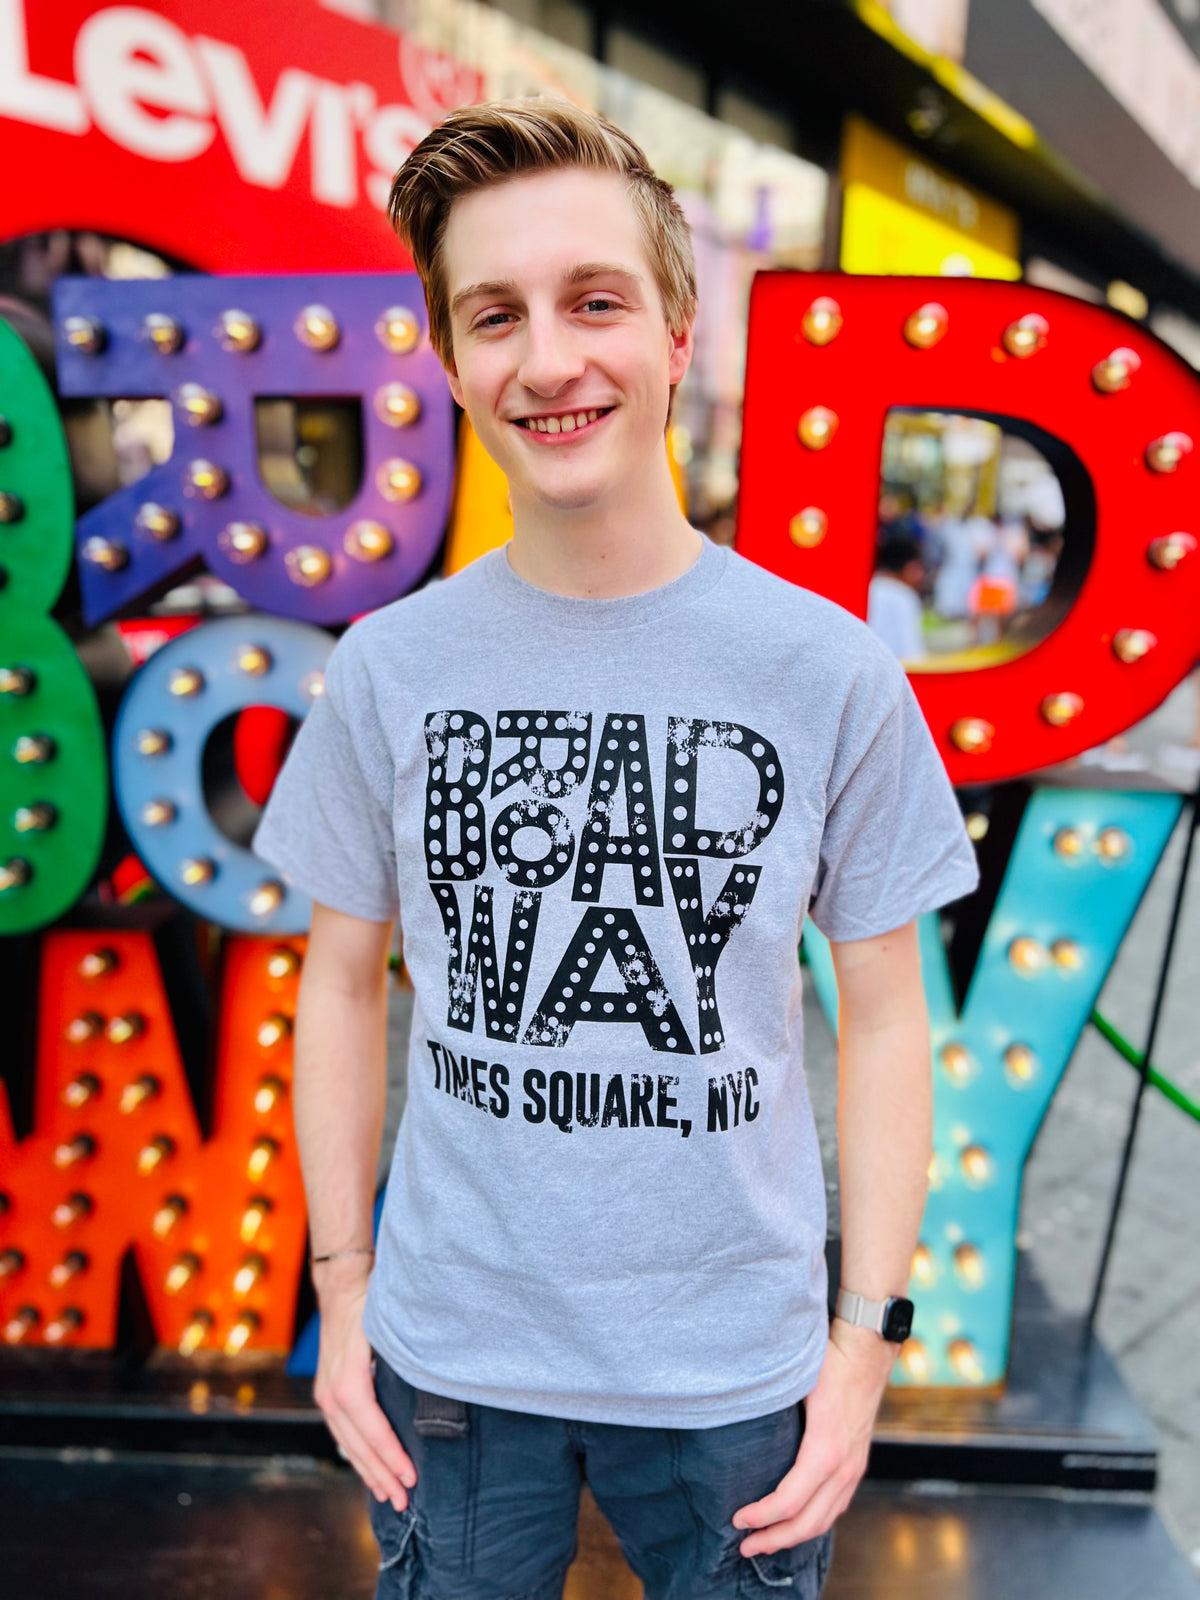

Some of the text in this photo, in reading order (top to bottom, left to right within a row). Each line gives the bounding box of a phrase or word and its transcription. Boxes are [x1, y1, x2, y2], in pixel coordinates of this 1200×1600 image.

[428, 856, 764, 1056] WAY
[425, 1038, 761, 1139] TIMES SQUARE, NYC
